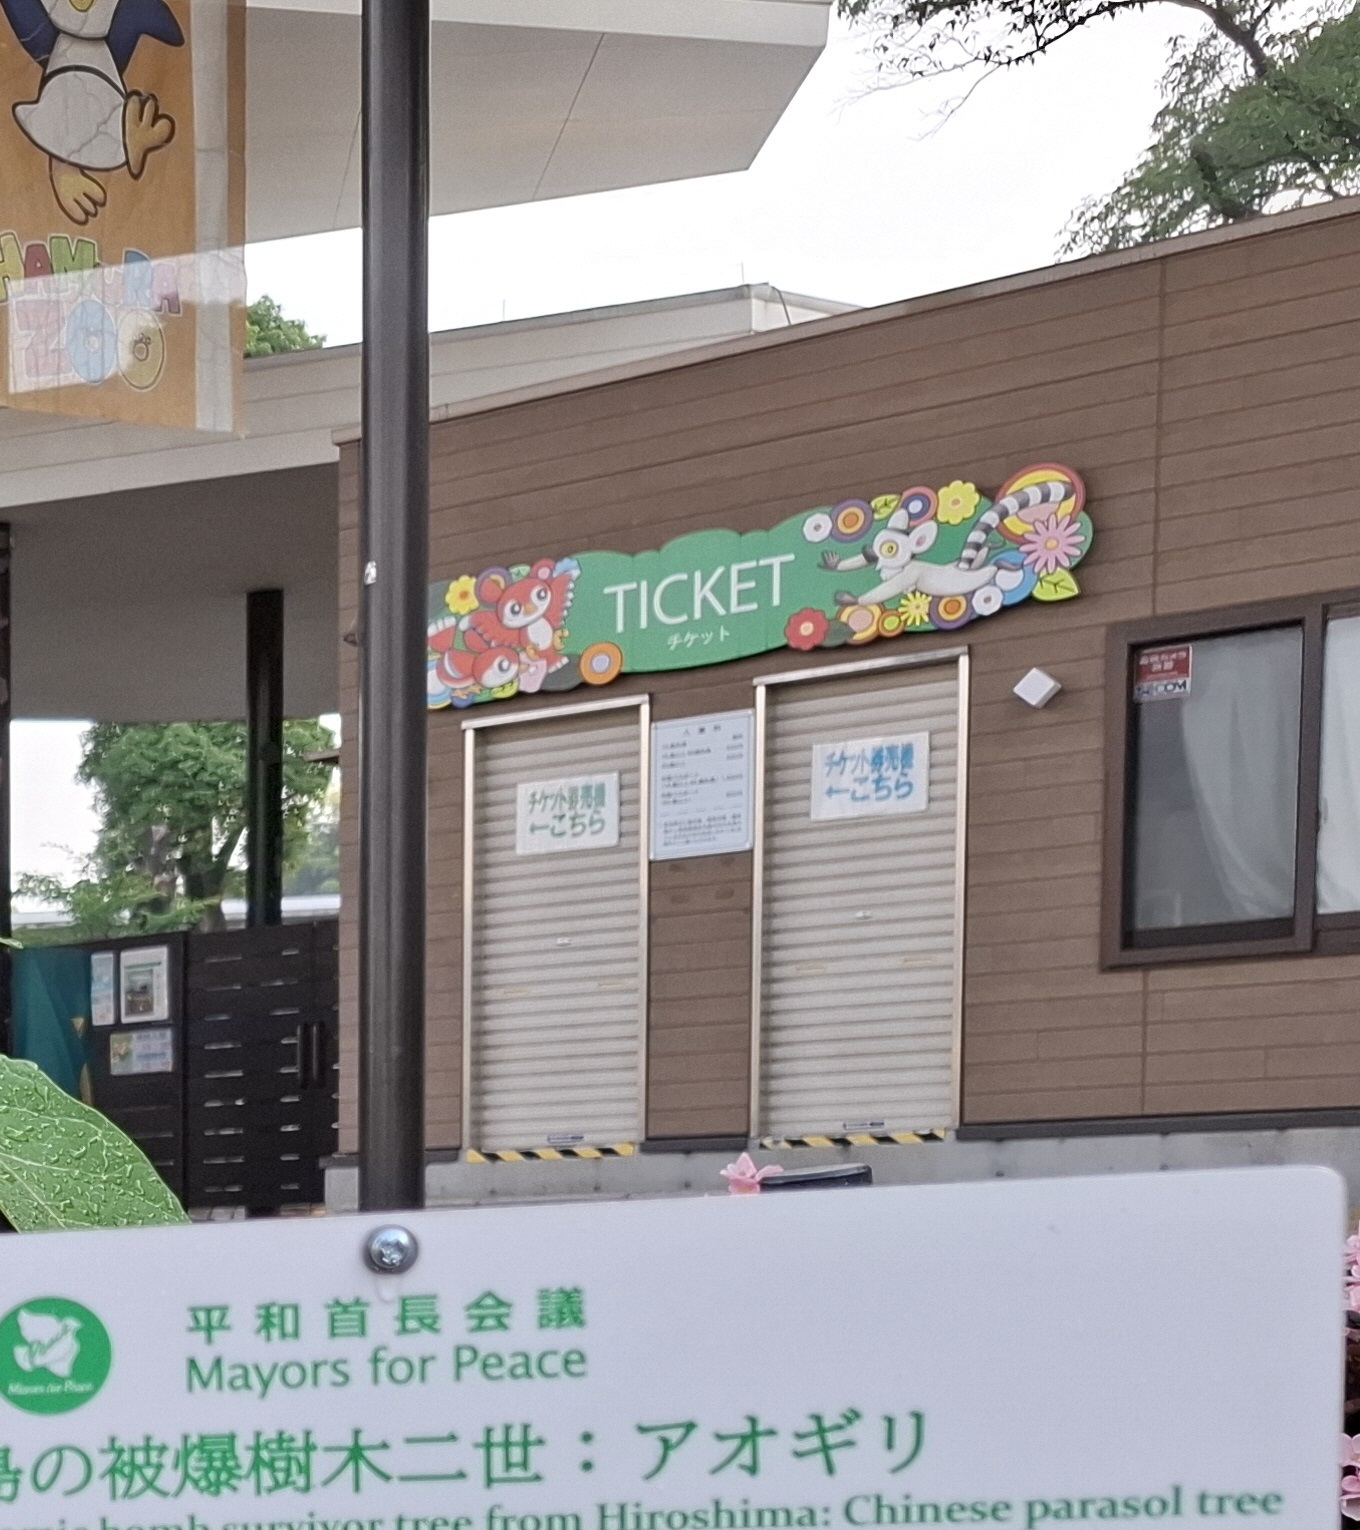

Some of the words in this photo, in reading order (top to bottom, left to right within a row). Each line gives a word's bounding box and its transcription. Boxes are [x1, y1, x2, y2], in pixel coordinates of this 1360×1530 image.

[13, 298, 166, 391] ZOO
[603, 553, 796, 634] TICKET
[667, 625, 730, 651] チケット
[850, 771, 914, 802] こちら
[550, 808, 606, 838] こちら
[187, 1286, 587, 1345] 平和首長会議
[186, 1355, 351, 1399] Mayors
[369, 1346, 436, 1386] for
[453, 1343, 587, 1382] Peace
[843, 1493, 1013, 1526] Chinese
[1195, 1489, 1284, 1517] tree
